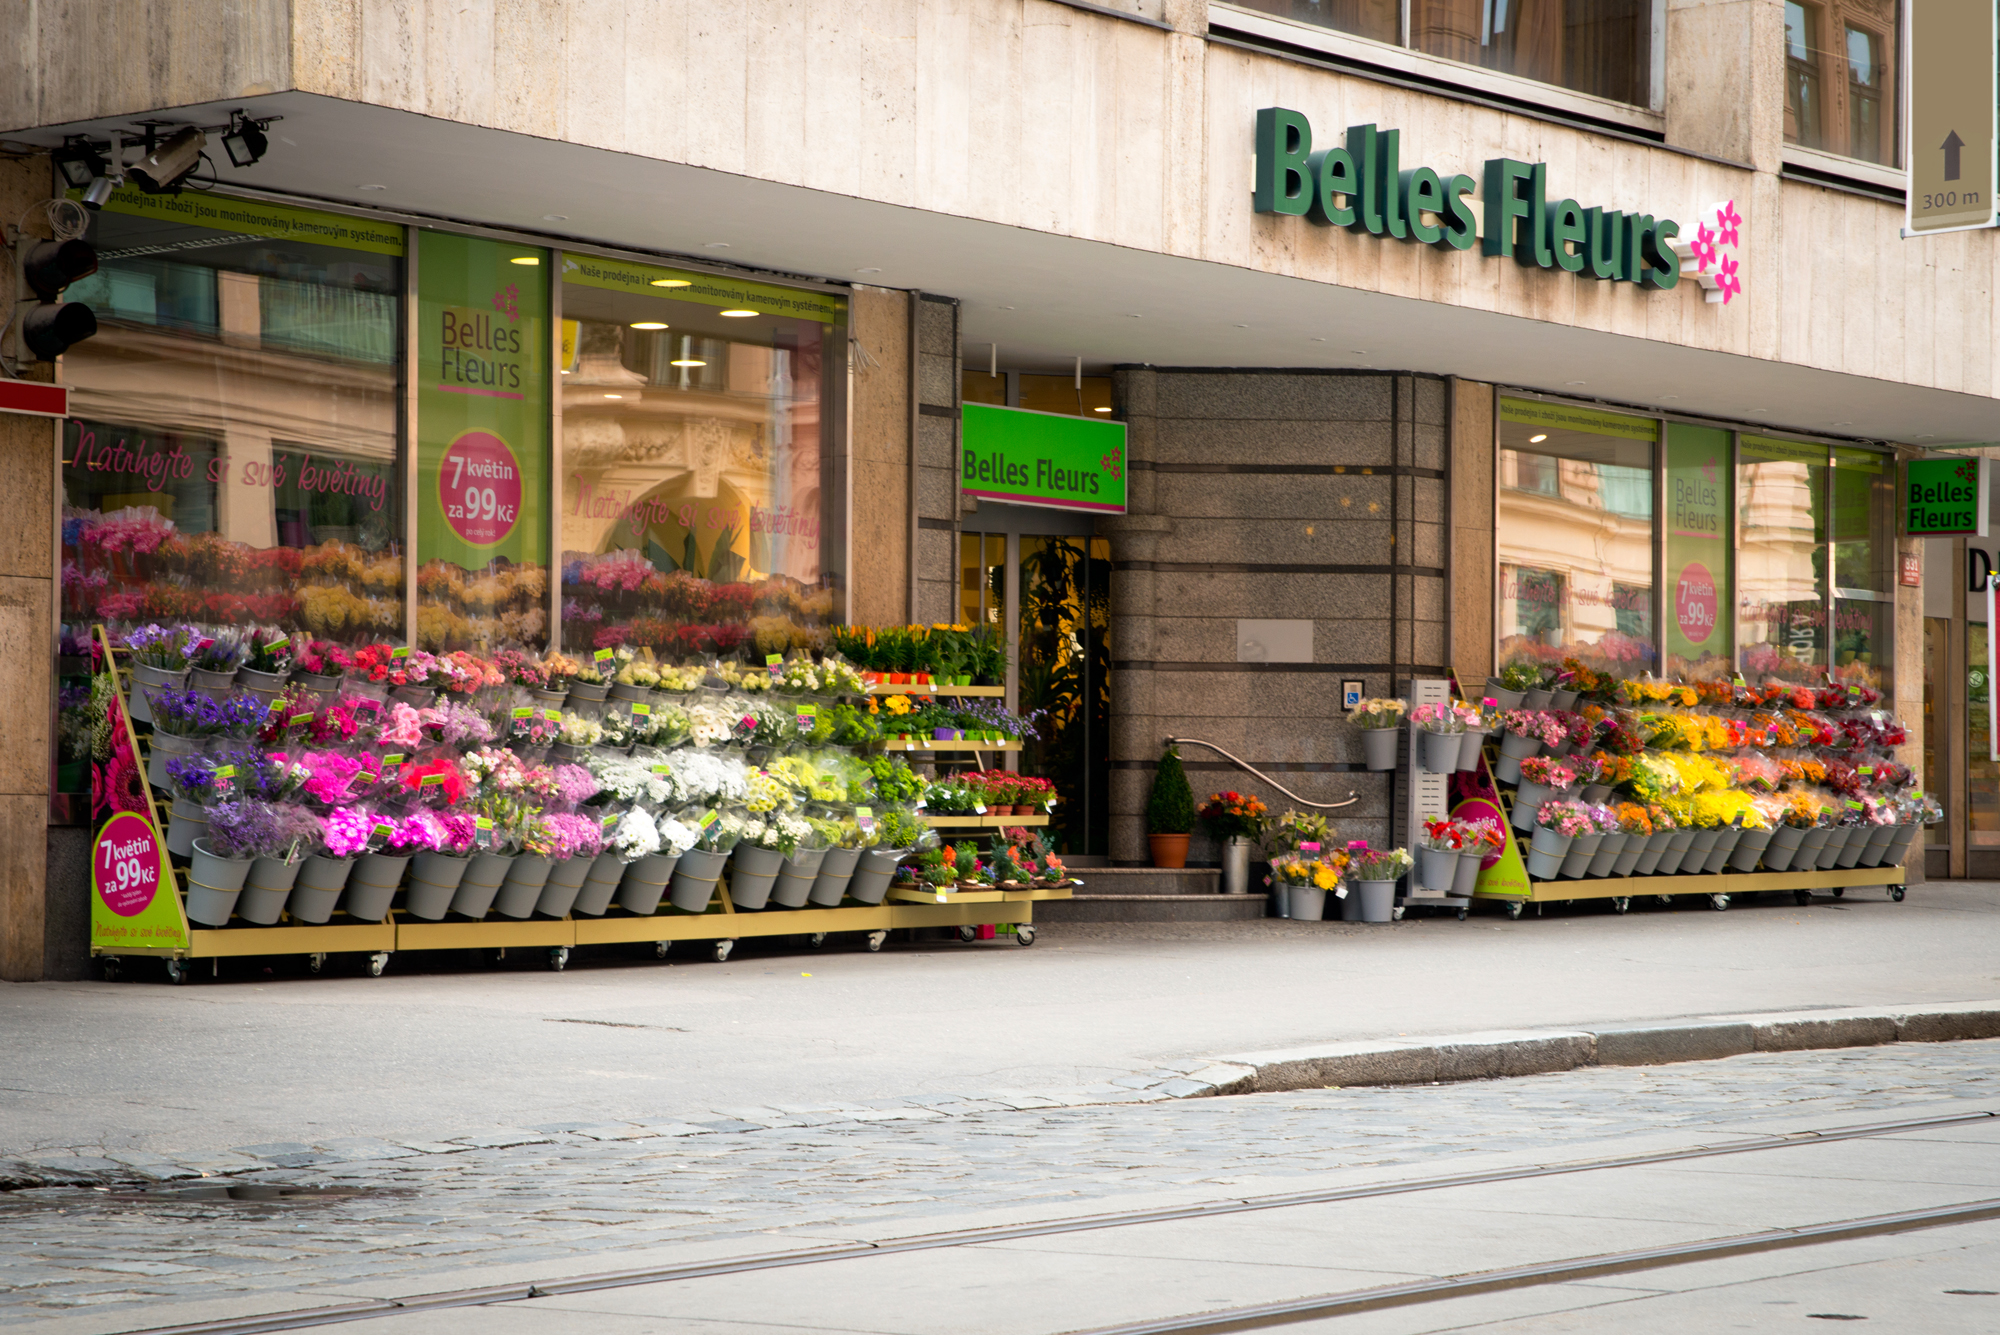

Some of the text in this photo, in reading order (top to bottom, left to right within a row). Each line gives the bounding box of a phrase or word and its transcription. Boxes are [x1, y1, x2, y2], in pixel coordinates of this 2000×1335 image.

[1256, 106, 1680, 290] Belles Fleurs
[1922, 191, 1980, 210] 300 m
[109, 189, 156, 208] prodejna
[165, 199, 193, 214] zboží
[194, 205, 217, 218] jsou
[220, 209, 291, 232] monitorovány
[292, 218, 349, 239] kamerovým
[350, 230, 402, 246] systémem.
[580, 264, 601, 277] Naše
[603, 270, 640, 286] prodejna
[690, 284, 746, 303] monitorovány
[746, 290, 791, 309] kamerovým
[792, 301, 834, 315] systémem.
[442, 310, 520, 354] Belles
[442, 346, 520, 389] Fleurs
[71, 420, 387, 512] Natrhejte si své květiny
[449, 455, 513, 489] 7 květin
[963, 449, 1100, 495] Belles Fleurs
[448, 486, 514, 523] za 99 Kč
[1676, 478, 1717, 507] Belles
[1910, 481, 1974, 504] Belles
[574, 473, 820, 550] Natrhejte si své květiny
[1676, 503, 1717, 532] Fleurs
[1909, 507, 1973, 529] Fleurs
[1680, 578, 1714, 604] 7 květin
[1679, 602, 1714, 627] za 99 Kč
[100, 839, 113, 869] 7
[104, 880, 118, 894] za
[116, 858, 141, 891] 99
[141, 866, 156, 884] Kč
